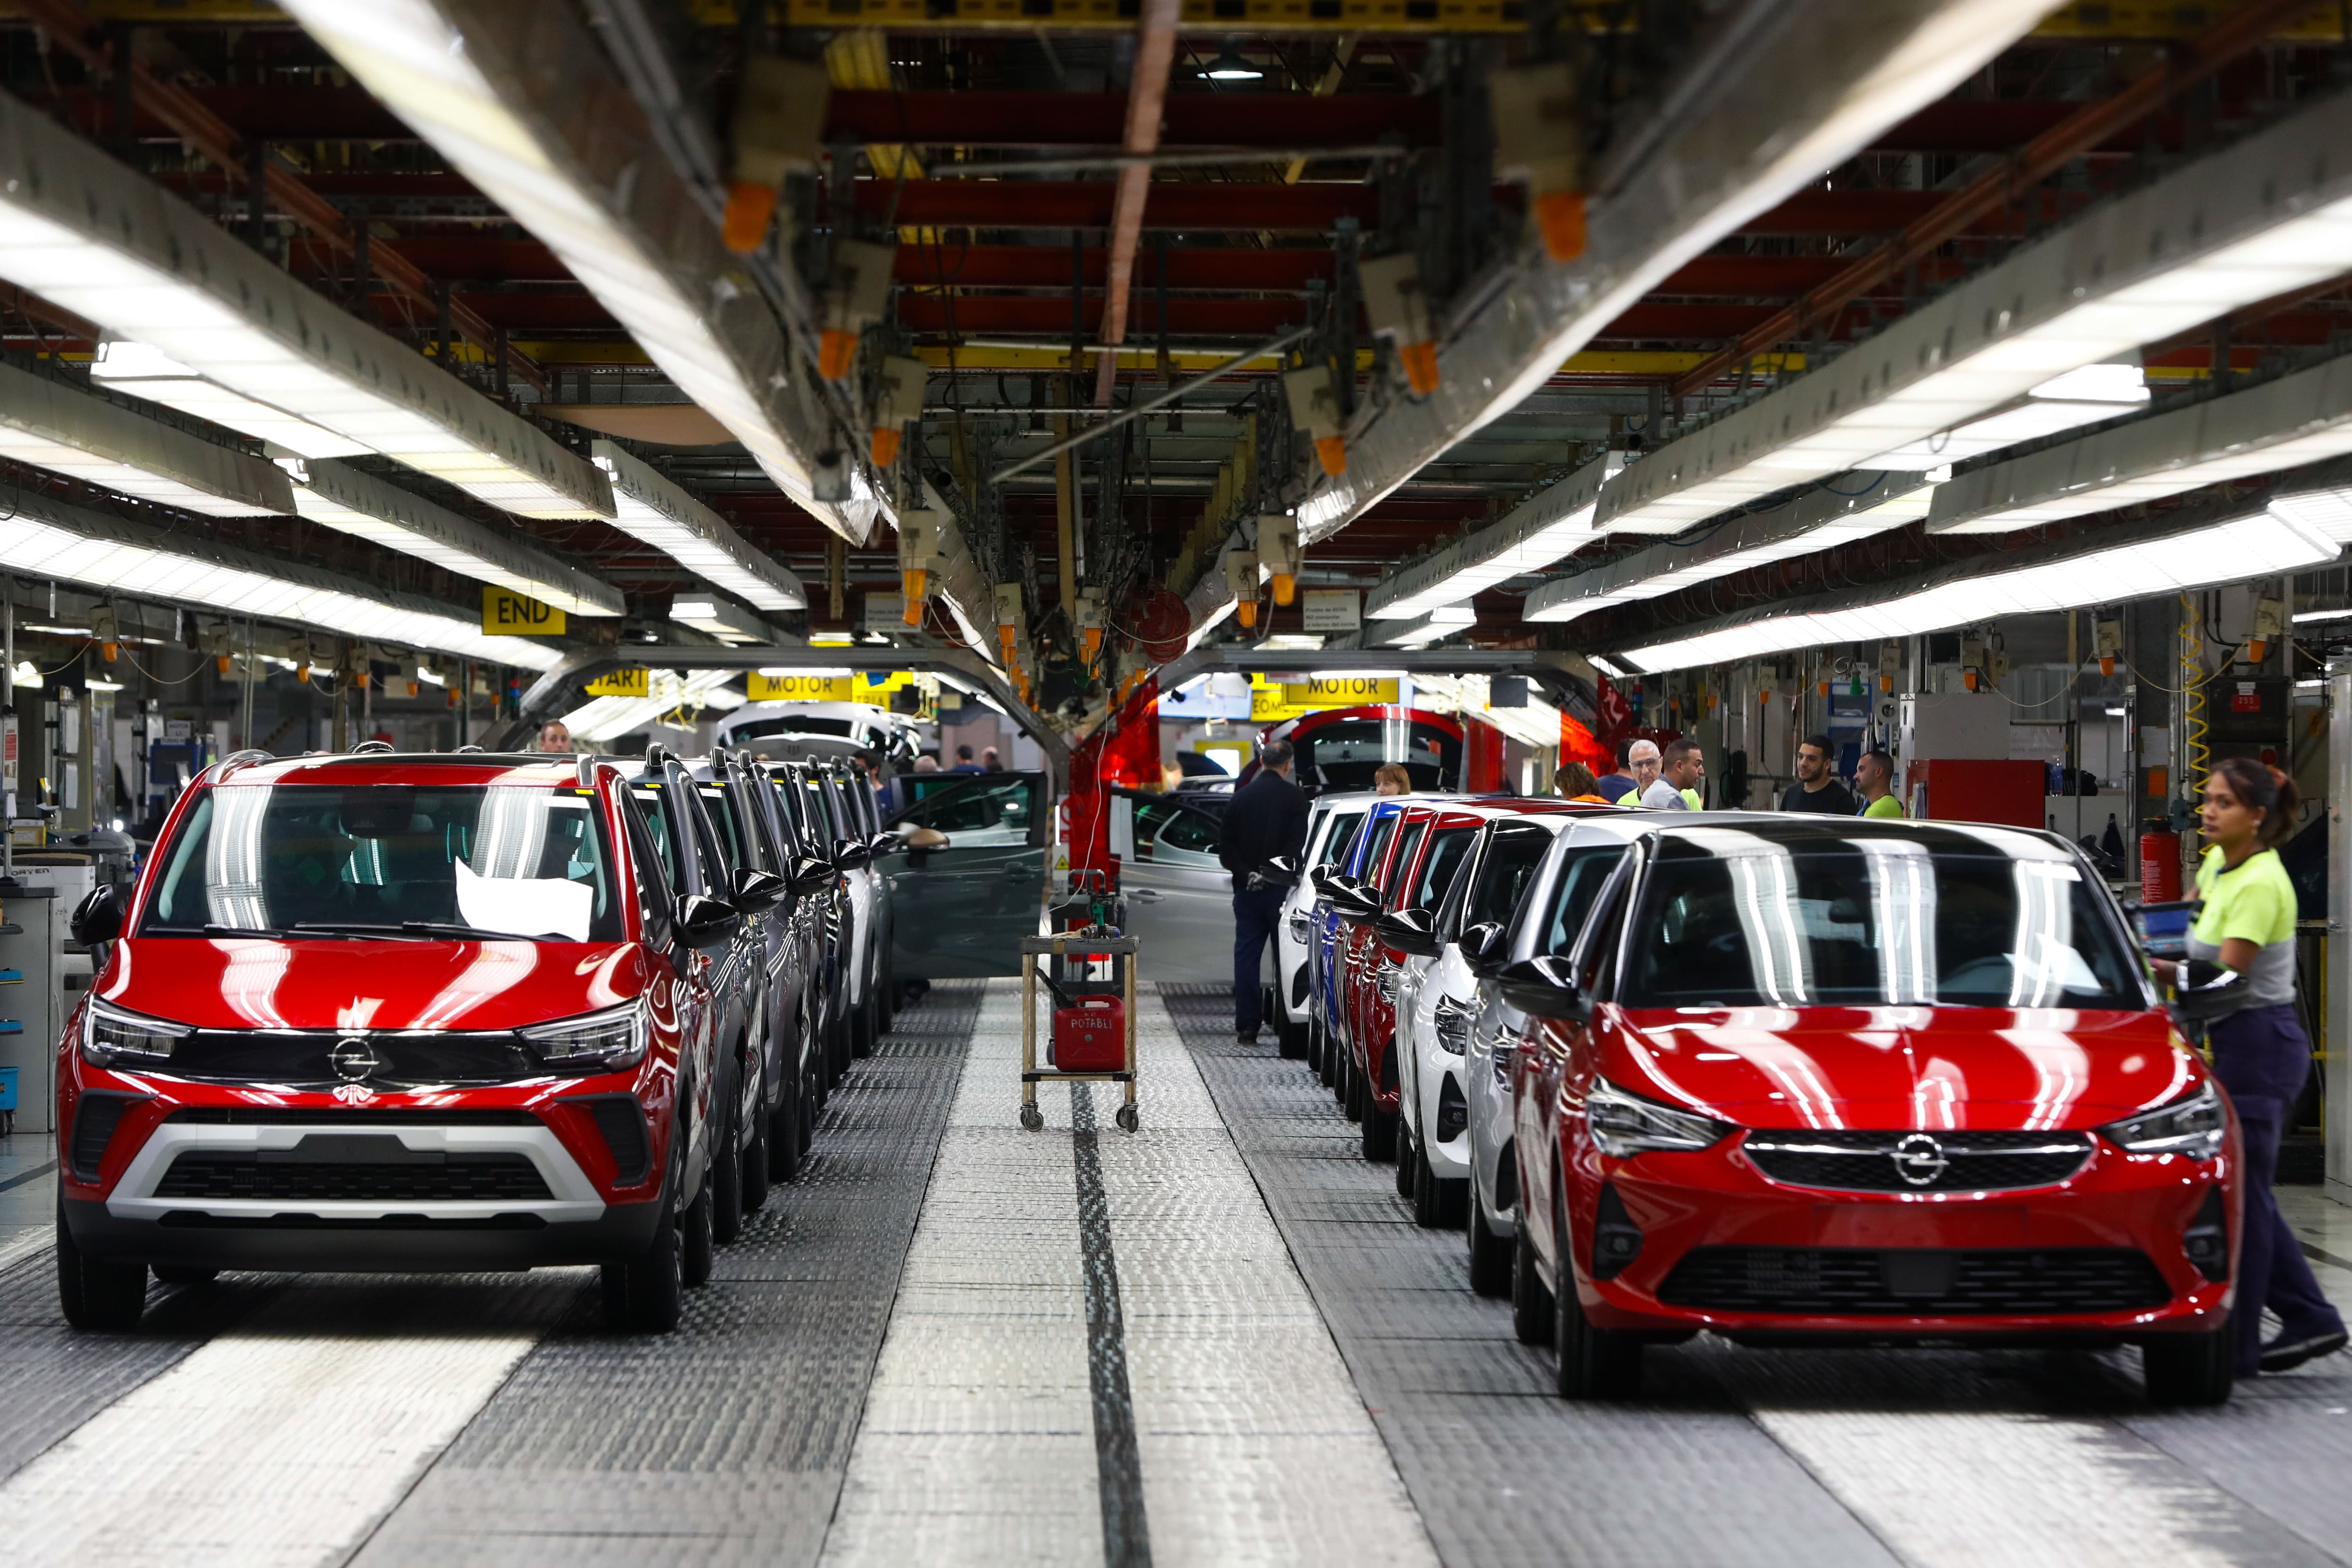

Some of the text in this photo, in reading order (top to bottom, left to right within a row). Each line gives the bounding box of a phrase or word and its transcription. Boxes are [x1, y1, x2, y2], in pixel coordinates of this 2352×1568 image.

[498, 597, 550, 623] END
[767, 676, 833, 692] MOTOR
[1308, 677, 1378, 694] MOTOR
